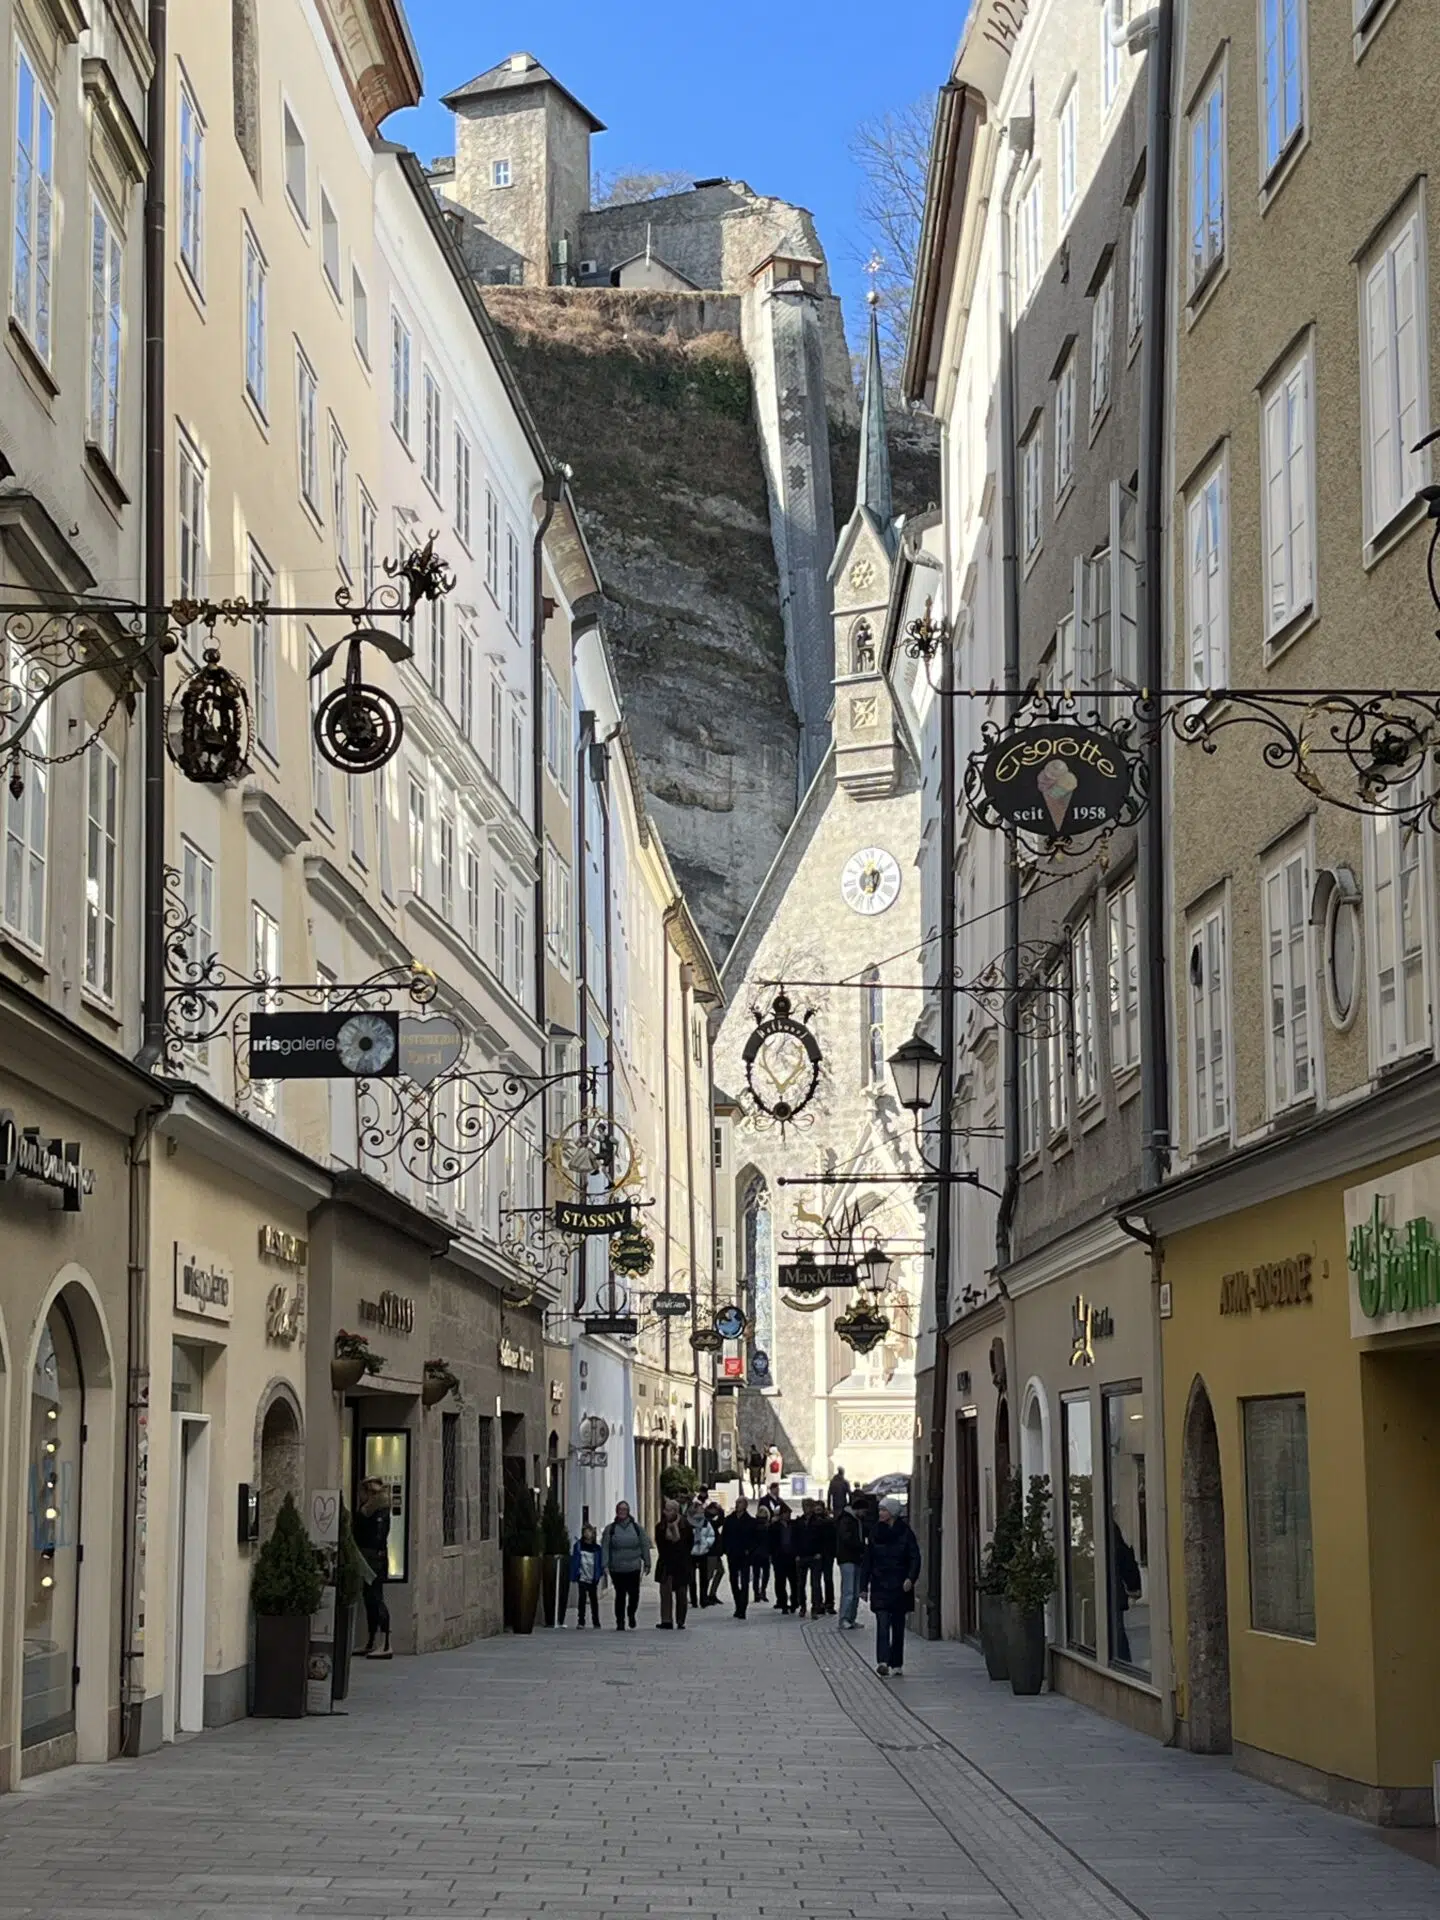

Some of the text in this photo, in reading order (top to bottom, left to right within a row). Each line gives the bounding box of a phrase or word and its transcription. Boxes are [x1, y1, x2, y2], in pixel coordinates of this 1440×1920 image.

[995, 735, 1118, 783] Eisgrotte
[1013, 806, 1108, 821] seit 1958
[252, 1036, 336, 1056] irisgalerie
[561, 1209, 627, 1229] STASSNY
